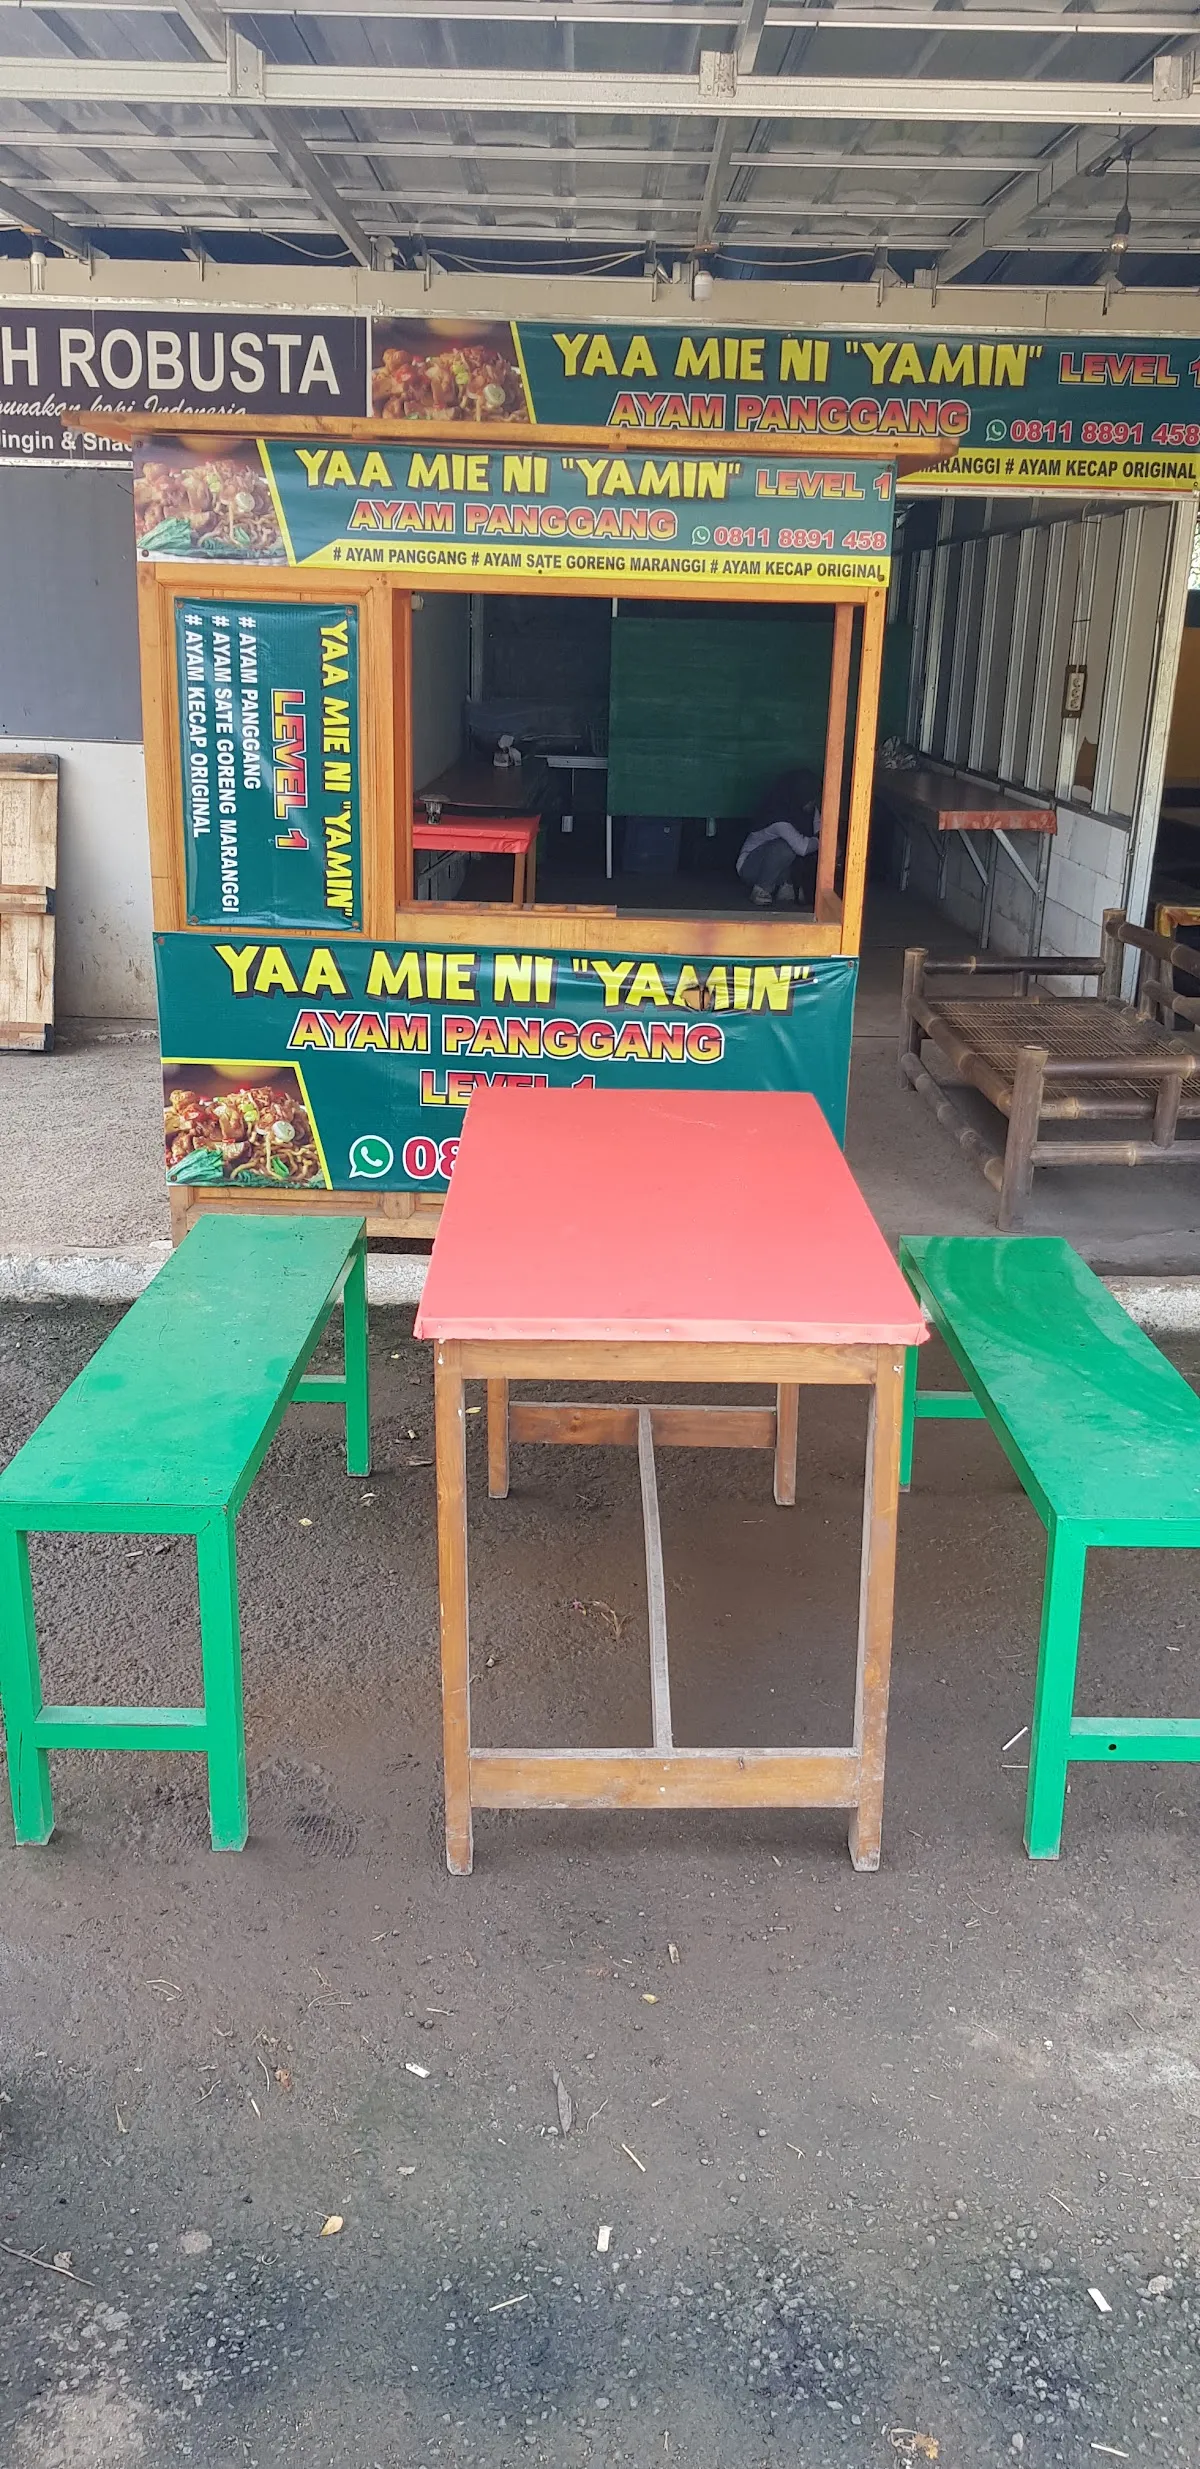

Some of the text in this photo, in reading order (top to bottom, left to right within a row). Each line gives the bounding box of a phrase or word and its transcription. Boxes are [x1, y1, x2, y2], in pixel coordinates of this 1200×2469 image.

[2, 327, 340, 395] H ROBUSTA
[552, 333, 1043, 387] YAA MIE NI "YAMIN"
[1058, 352, 1180, 387] LEVEL
[605, 391, 971, 437] AYAM PANGGANG
[1010, 419, 1200, 446] 0811 8891 458
[61, 431, 76, 450] &
[83, 432, 133, 452] Sna
[295, 449, 740, 499] YAA MIE NI "YAMIN"
[755, 469, 892, 500] LEVEL 1
[920, 457, 1000, 475] ARANGGI
[1018, 458, 1061, 476] AYAM
[1066, 459, 1118, 477] KECAP
[1123, 461, 1196, 479] ORIGINAL
[347, 499, 678, 540] AYAM PANGGANG
[714, 526, 886, 550] 0811 8891 458
[346, 547, 384, 563] AYAM
[388, 549, 467, 565] PANGGANG
[484, 552, 522, 568] AYAM
[526, 553, 562, 568] SATE
[566, 555, 626, 570] GORENG
[630, 557, 705, 573] MARANGGI
[722, 561, 760, 576] AYAM
[765, 561, 812, 577] KECAP
[817, 562, 884, 579] ORIGINAL
[185, 629, 205, 682] AYAM
[212, 631, 232, 683] AYAM
[239, 632, 258, 684] AYAM
[187, 686, 208, 748] KECAP
[214, 687, 233, 734] SATE
[241, 689, 261, 790] PANGGANG
[189, 751, 211, 838] ORIGINAL
[216, 739, 236, 814] GORENG
[271, 688, 310, 850] LEVEL 1
[319, 620, 353, 917] YAA MIE NI "YAMIN"
[219, 819, 239, 912] MARANGGI
[213, 944, 350, 999] YAA
[365, 949, 481, 1006] MIE
[493, 953, 557, 1008] NI
[286, 1009, 724, 1064] AYAM PANGGANG
